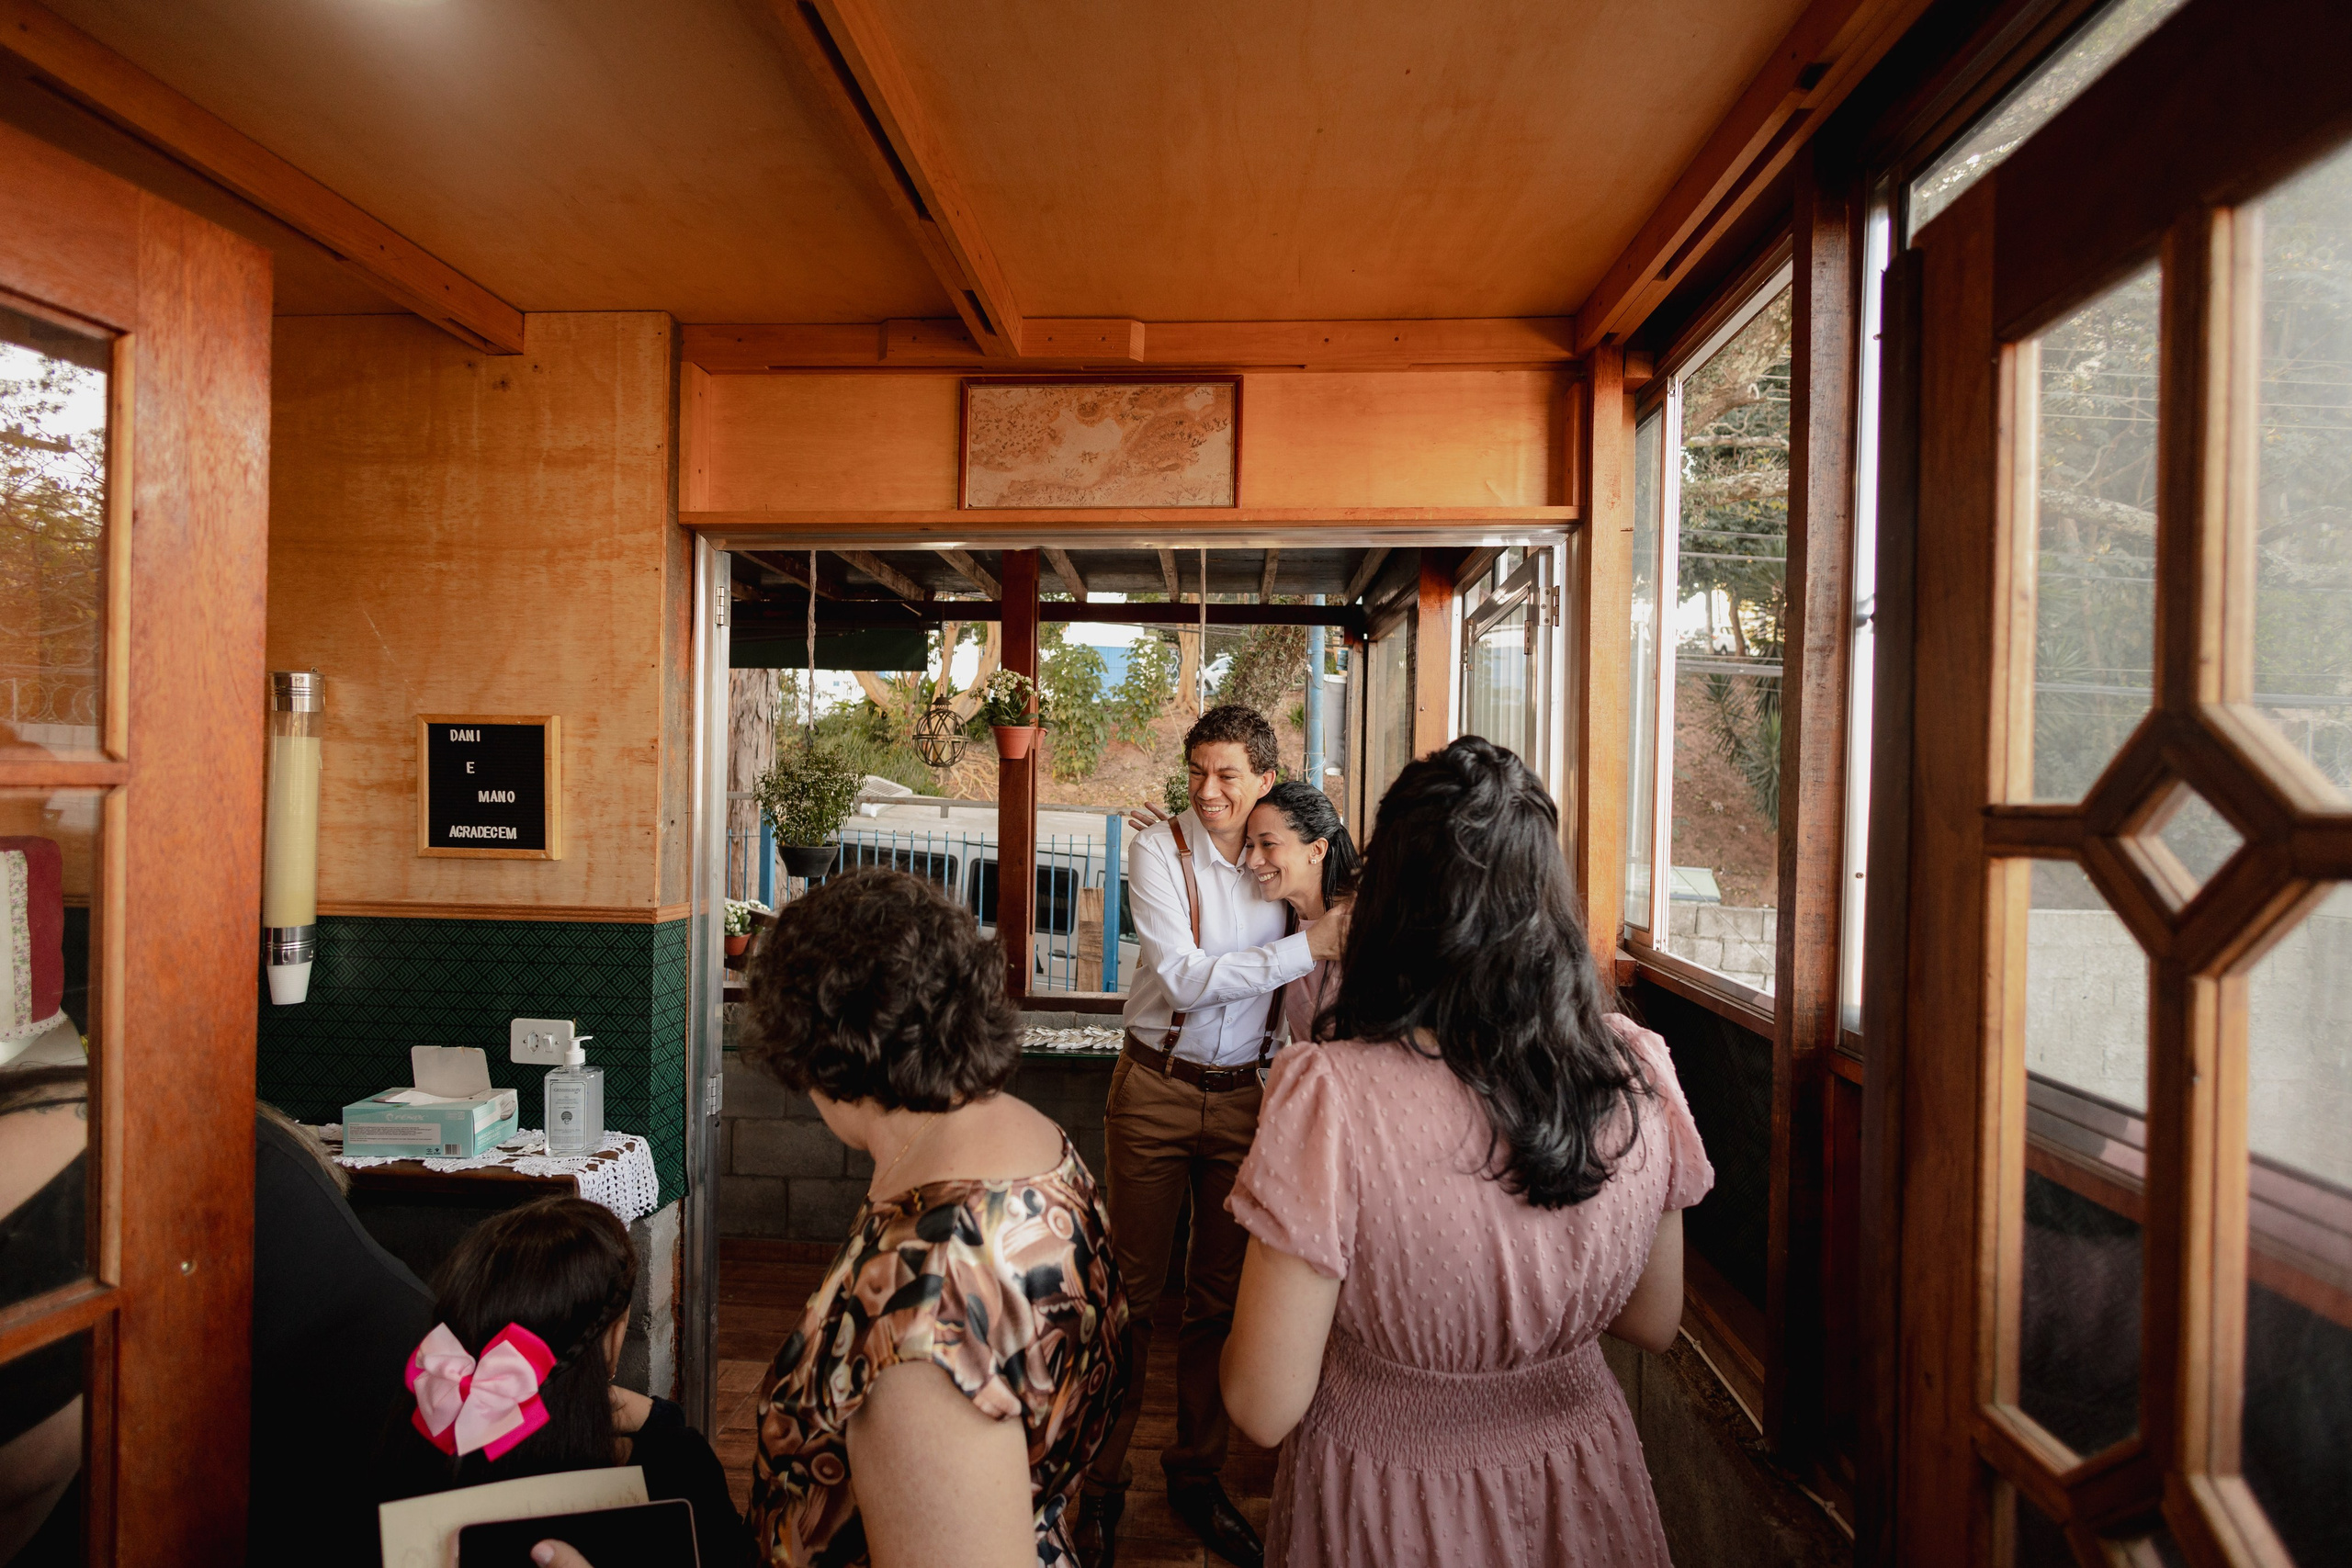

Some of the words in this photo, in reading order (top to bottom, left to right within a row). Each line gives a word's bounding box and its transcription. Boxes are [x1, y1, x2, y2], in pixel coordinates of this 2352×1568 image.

[449, 728, 481, 742] DANI
[466, 761, 475, 774] E
[478, 790, 515, 803] MANO
[448, 825, 517, 840] AGRADECEM
